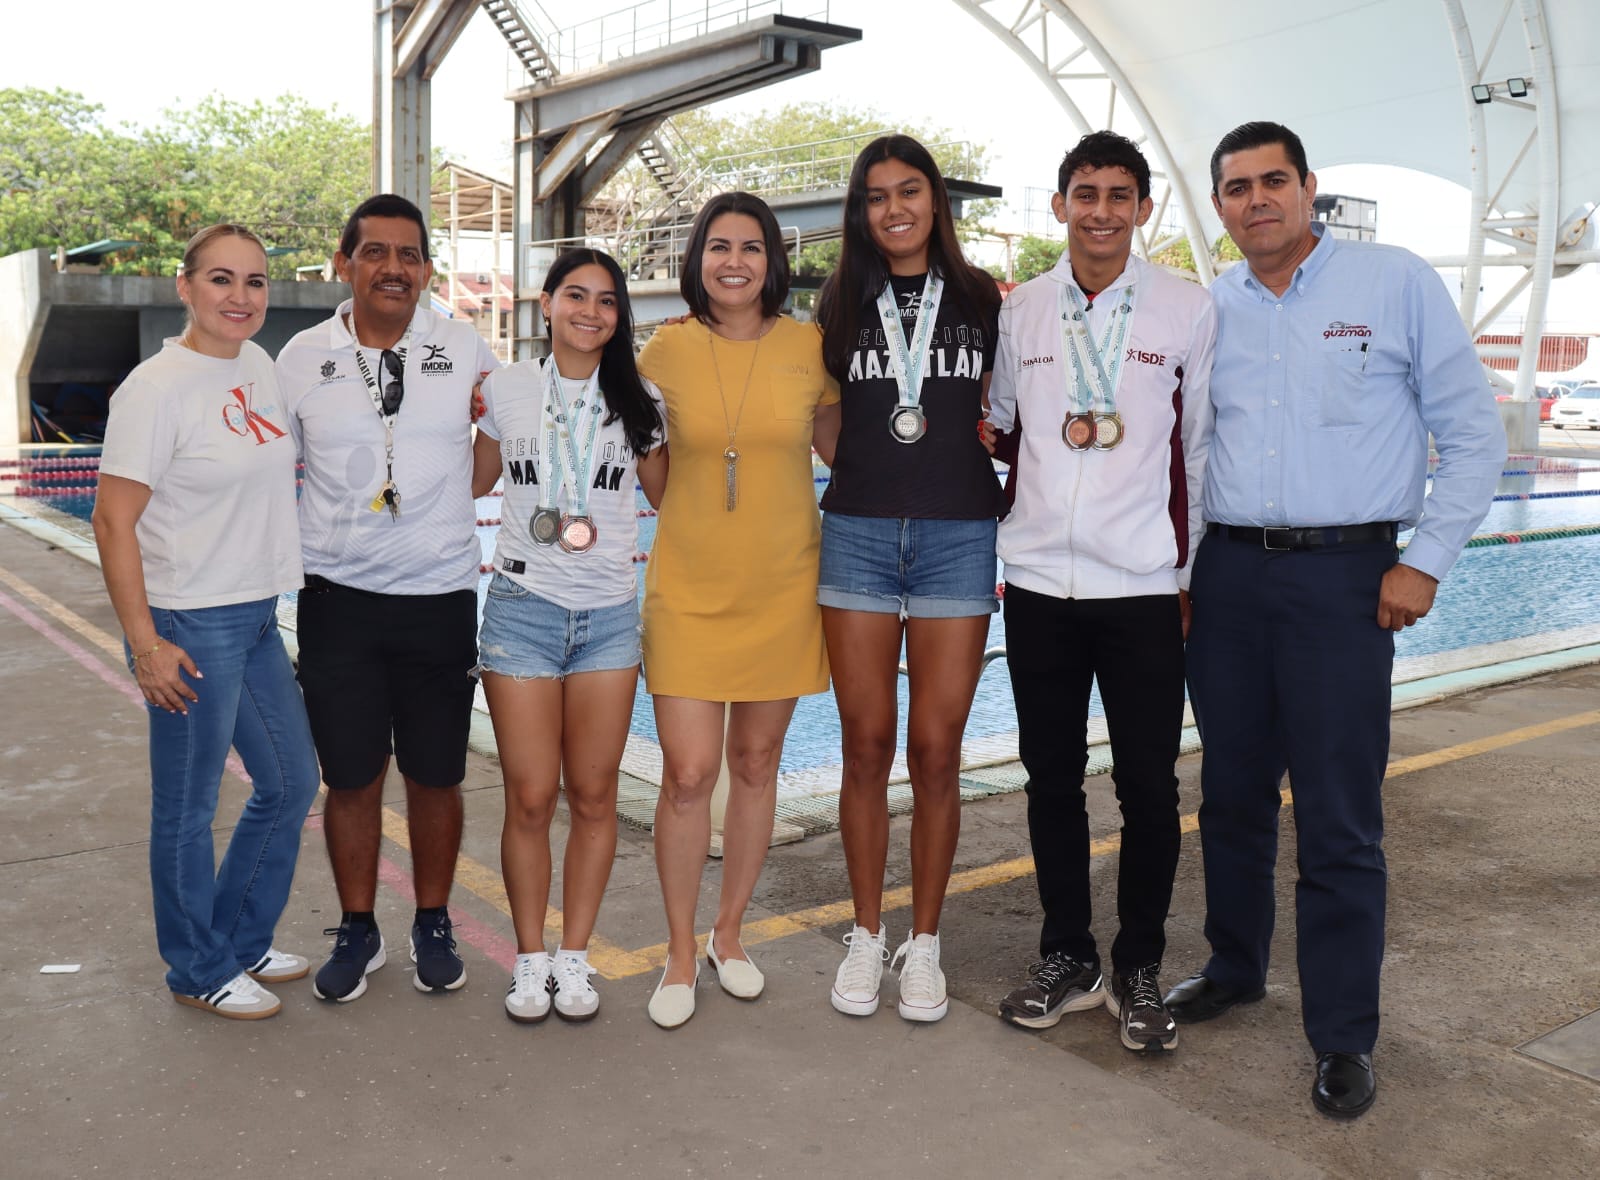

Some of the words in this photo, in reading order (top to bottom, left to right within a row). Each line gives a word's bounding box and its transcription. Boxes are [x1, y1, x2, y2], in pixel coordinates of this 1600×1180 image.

[848, 345, 983, 382] MAZTLÁN
[1022, 356, 1054, 367] SINALOA
[1137, 350, 1166, 366] ISDE
[421, 361, 453, 371] IMDEM
